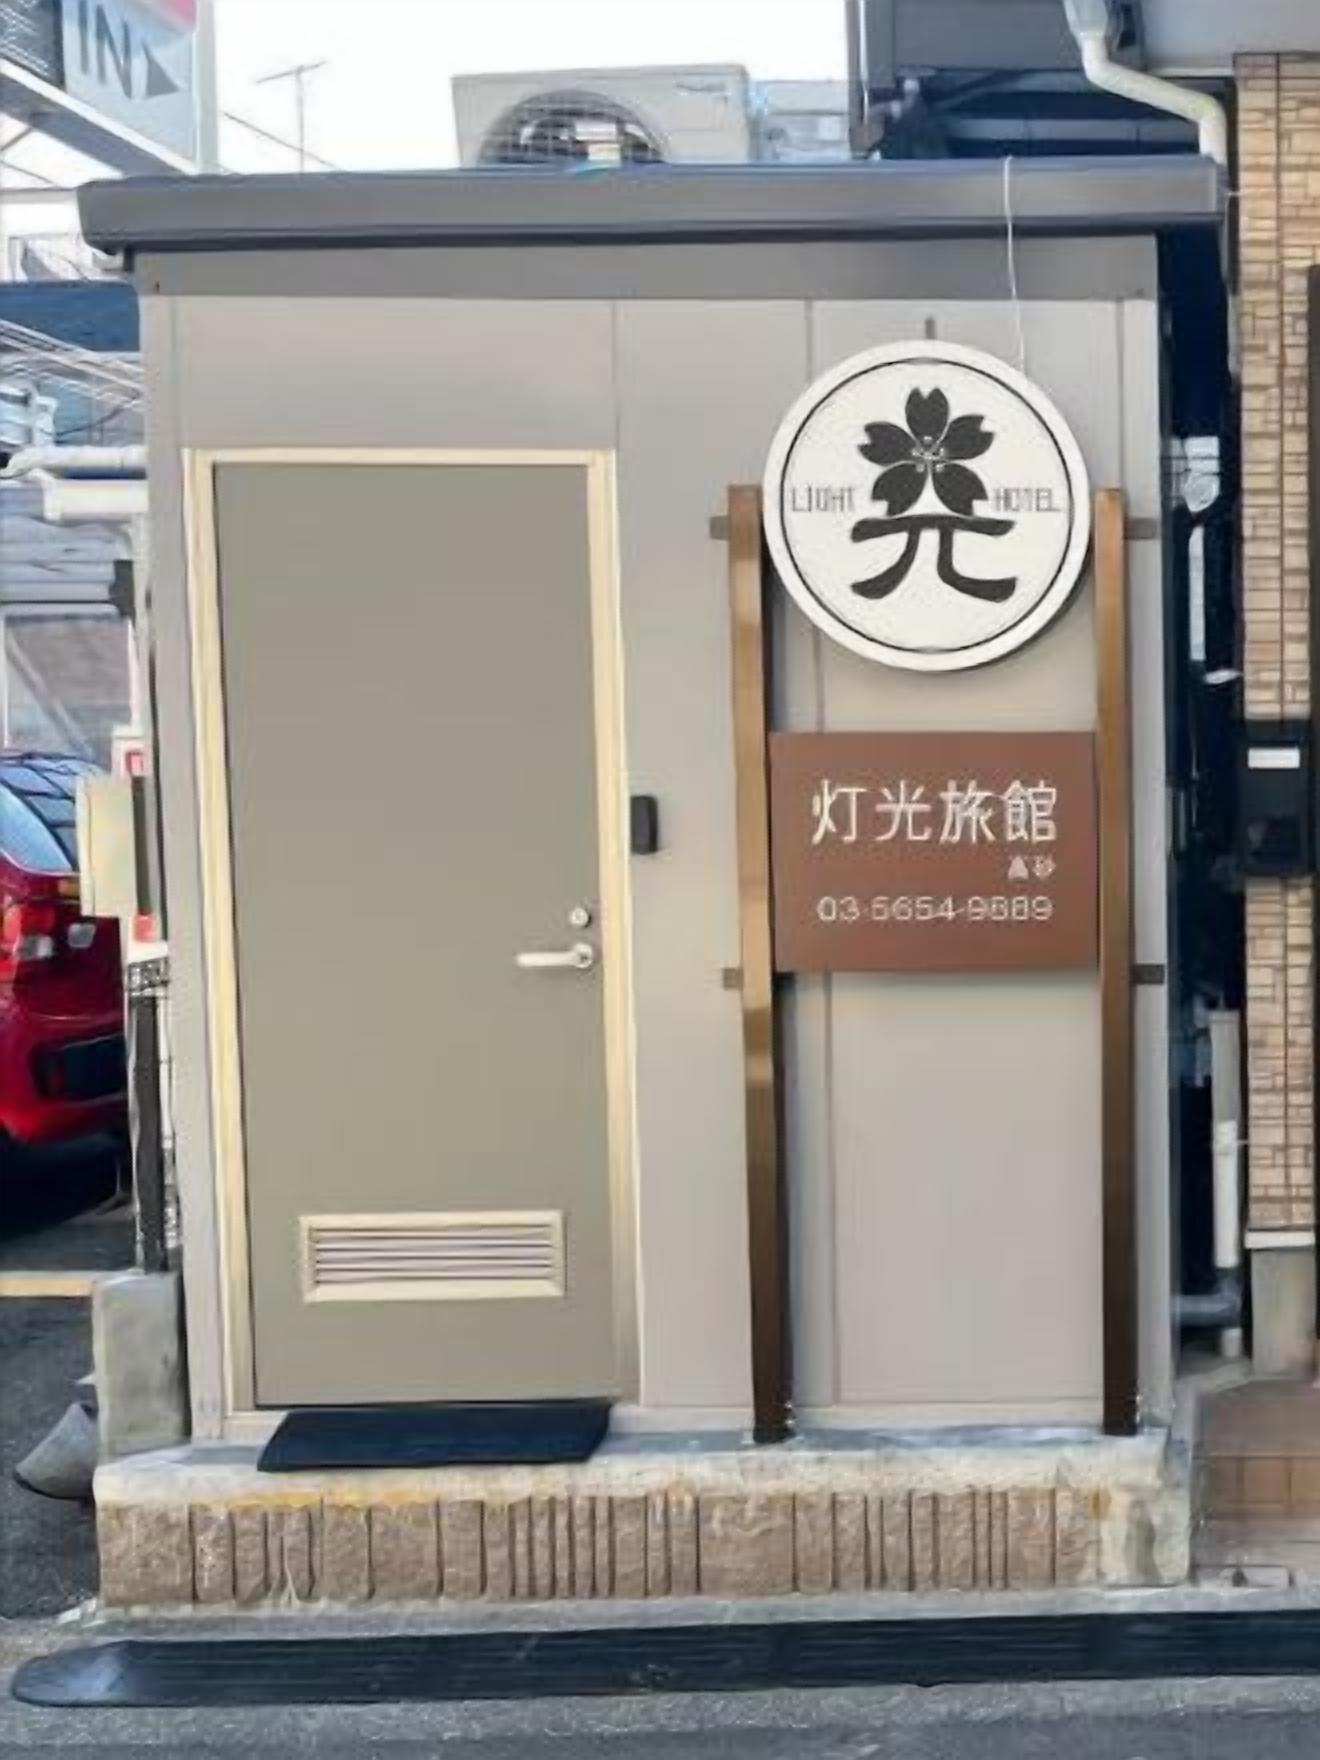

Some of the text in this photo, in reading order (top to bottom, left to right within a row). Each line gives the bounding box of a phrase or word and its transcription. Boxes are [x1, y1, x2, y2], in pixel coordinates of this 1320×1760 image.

[77, 0, 132, 99] IN
[791, 487, 1061, 513] LIGHT HOTEL
[811, 779, 1057, 845] 灯光旅館
